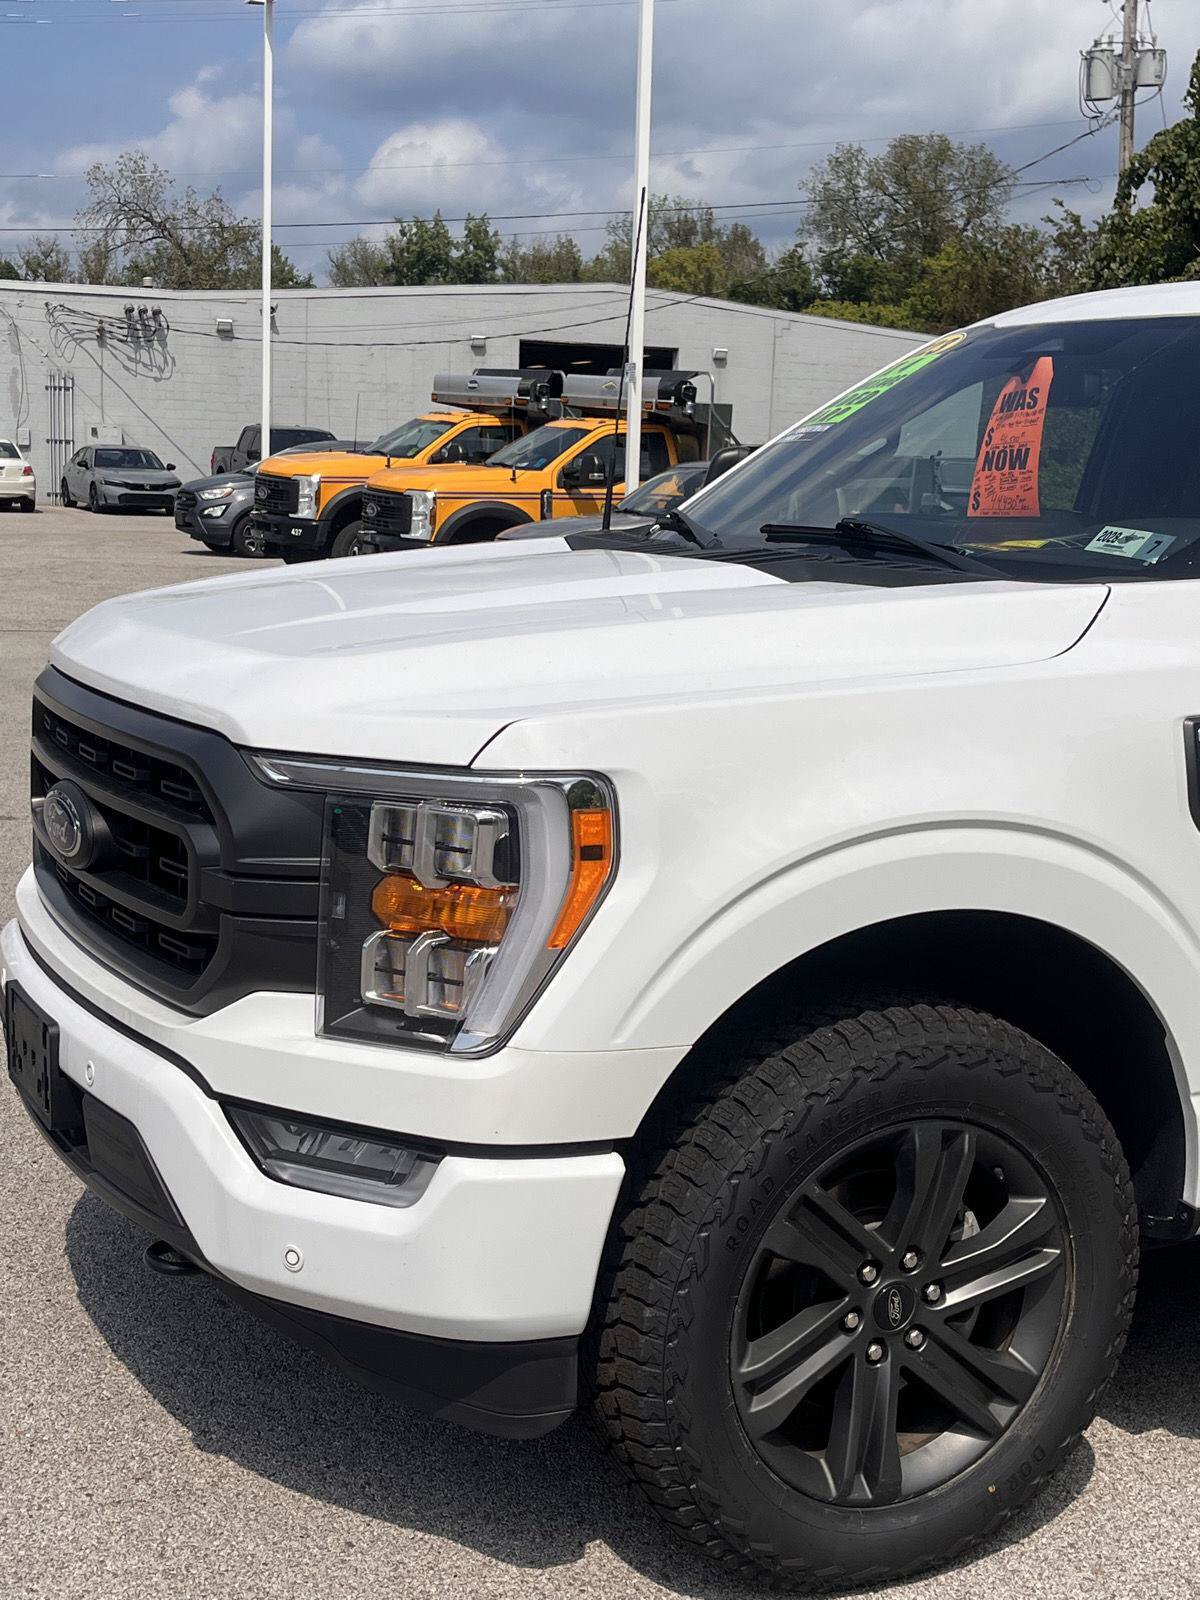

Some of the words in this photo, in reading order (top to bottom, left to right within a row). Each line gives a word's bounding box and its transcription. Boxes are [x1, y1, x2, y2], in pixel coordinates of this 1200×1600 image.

[1000, 387, 1040, 413] WAS
[981, 448, 1030, 471] NOW
[290, 528, 303, 536] 437
[726, 1176, 776, 1251] ROAD
[890, 1296, 900, 1320] Ford
